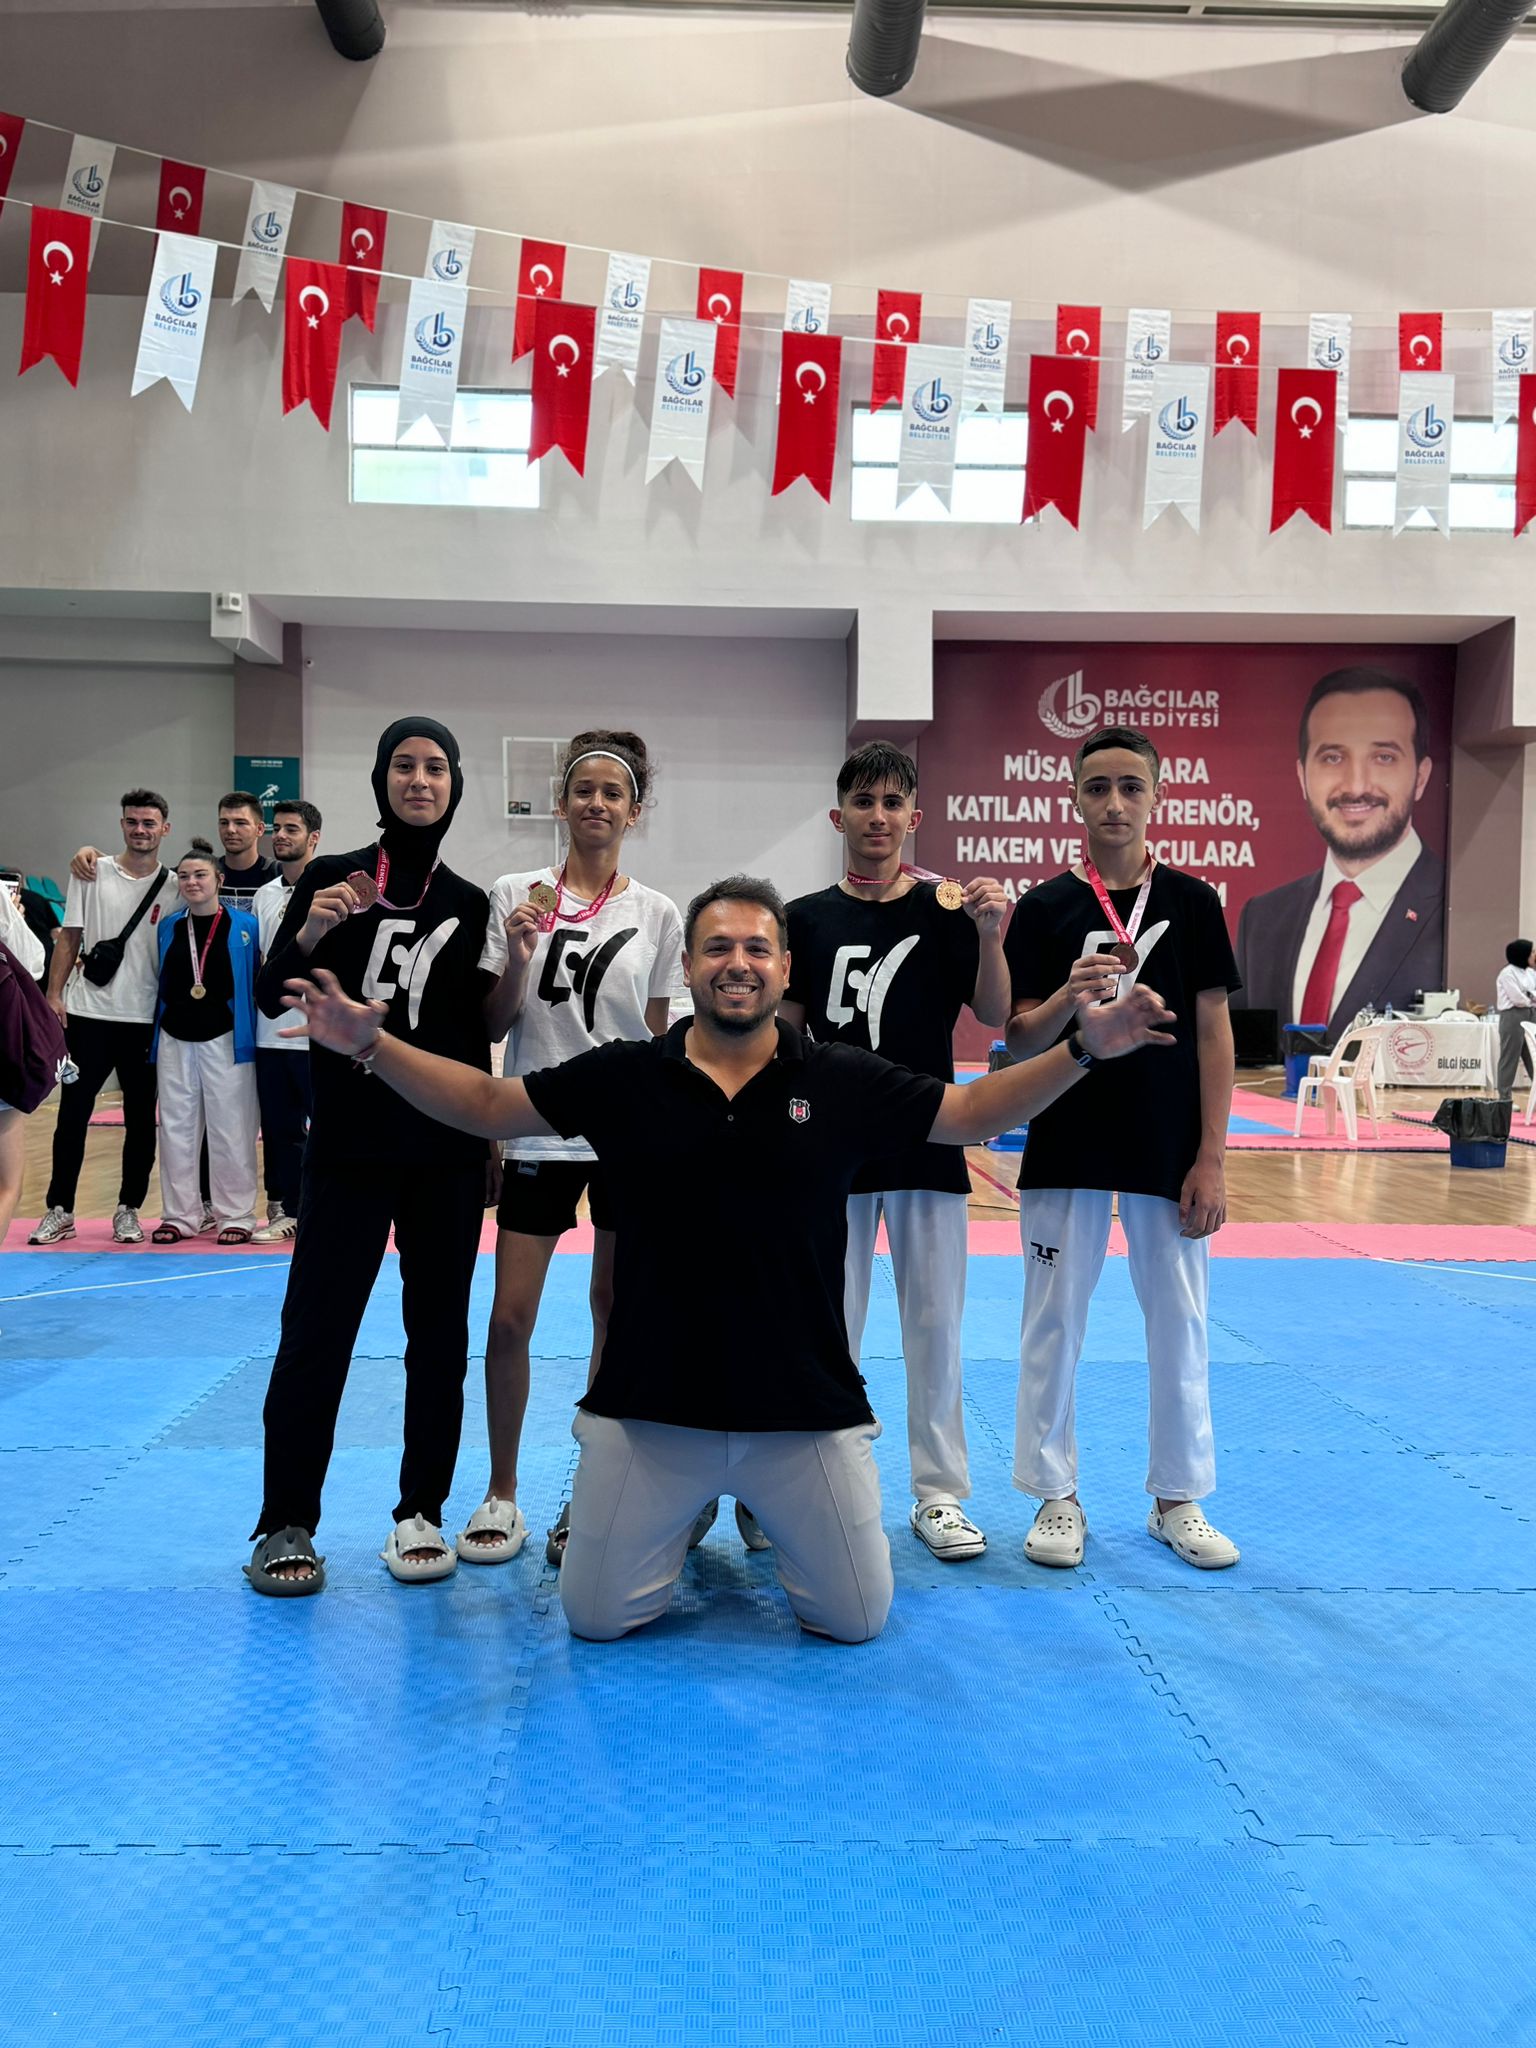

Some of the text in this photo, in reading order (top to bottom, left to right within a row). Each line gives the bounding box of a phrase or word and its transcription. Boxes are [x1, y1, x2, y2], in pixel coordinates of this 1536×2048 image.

[155, 313, 198, 329] BAĞCILAR
[411, 355, 452, 368] BAĞCILAR
[662, 395, 704, 406] BAĞCILAR
[910, 423, 950, 433] BAĞCILAR
[1156, 442, 1197, 451] BAĞCILAR
[1404, 449, 1445, 458] BAĞCILAR
[1104, 684, 1219, 708] BAĞCILAR
[1103, 708, 1219, 727] BELEDİYESİ
[947, 795, 1051, 823] KATILAN
[957, 836, 1043, 863] HAKEM
[1050, 838, 1082, 864] VE
[1437, 1056, 1458, 1070] BİLGİ
[1459, 1056, 1482, 1072] İŞLEM
